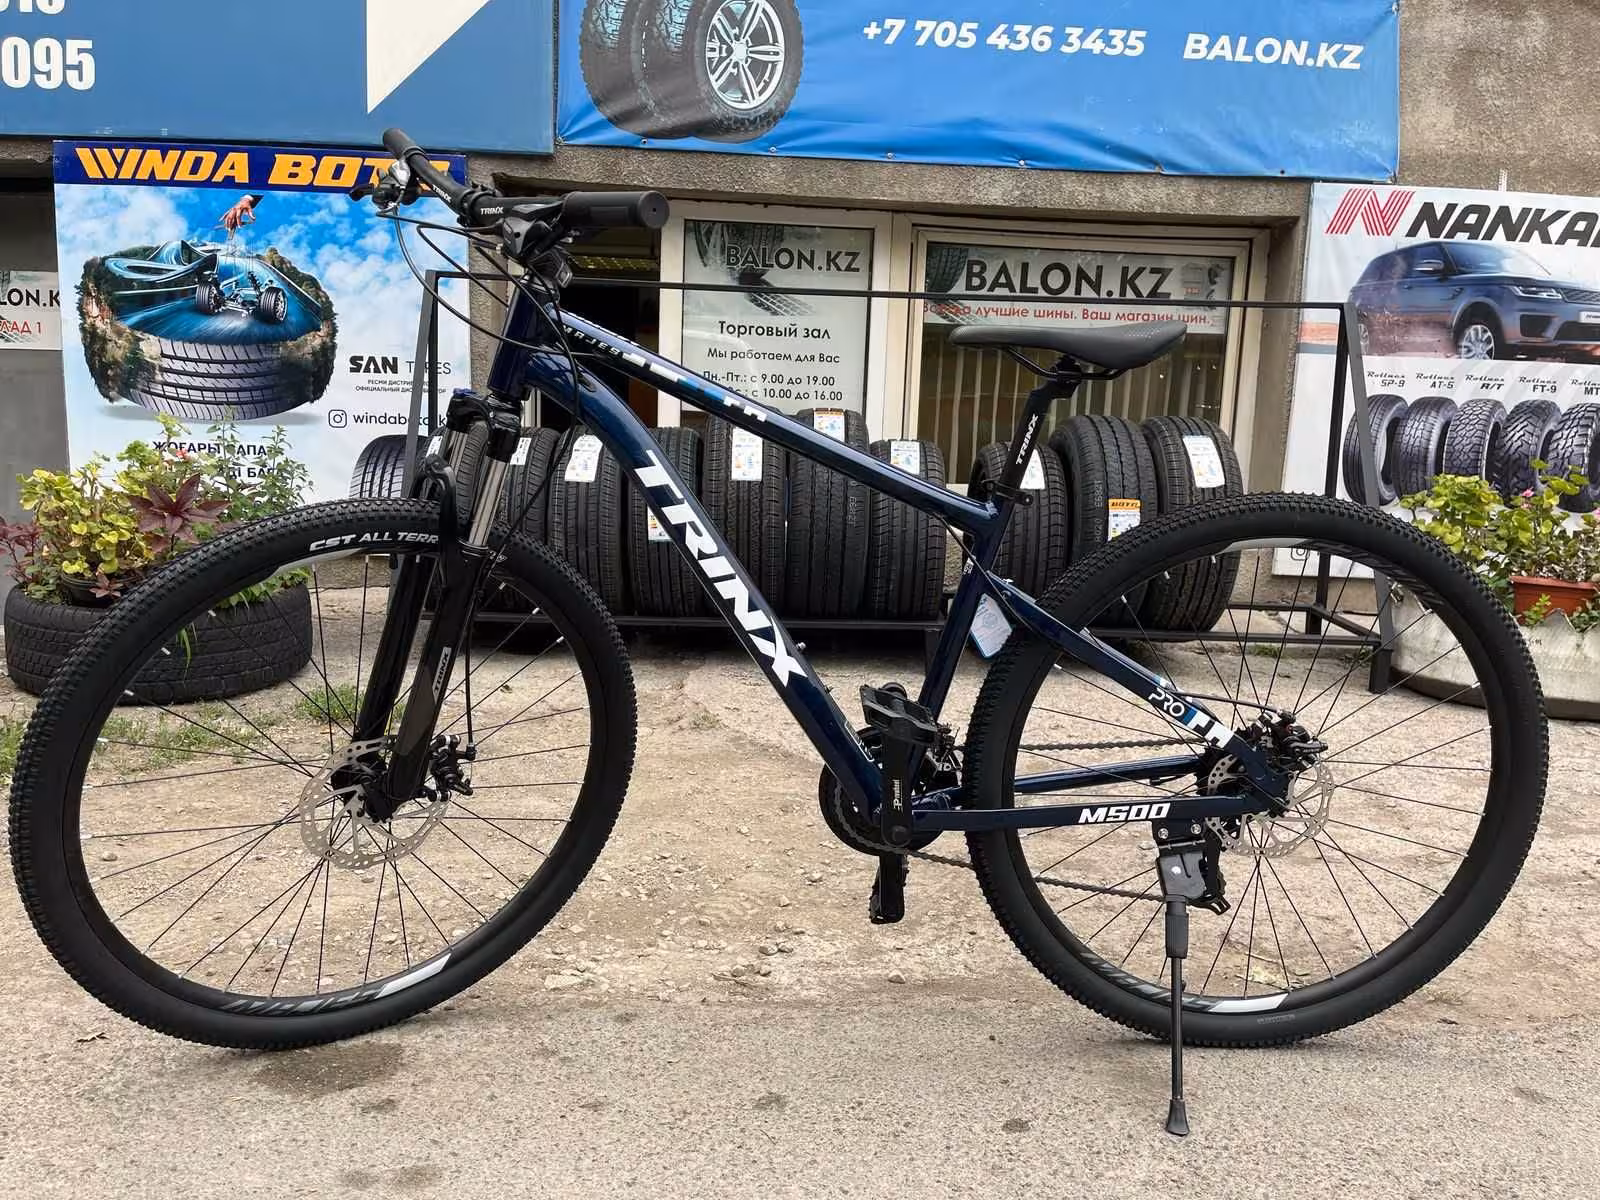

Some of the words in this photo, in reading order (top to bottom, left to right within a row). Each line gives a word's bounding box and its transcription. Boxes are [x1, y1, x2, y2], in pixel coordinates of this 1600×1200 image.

[863, 19, 905, 45] +7
[914, 20, 979, 48] 705
[986, 23, 1054, 52] 436
[1060, 27, 1147, 56] 3435
[1183, 33, 1365, 70] BALON.KZ
[2, 36, 96, 90] 095
[75, 147, 249, 184] WINDA
[432, 184, 451, 203] TRINX
[480, 207, 504, 215] TRINX
[1405, 201, 1600, 248] NANKA
[726, 244, 861, 273] BALON.KZ
[965, 259, 1173, 299] BALON.KZ
[975, 305, 1029, 318] лучшие
[1033, 308, 1077, 320] шины.
[1082, 308, 1111, 321] Ваш
[1115, 311, 1173, 322] магазин
[718, 320, 798, 338] Торговый
[802, 326, 831, 340] зал
[349, 355, 399, 374] SAN
[707, 348, 727, 358] Мы
[730, 349, 792, 362] работаем
[795, 352, 815, 363] для
[818, 353, 840, 363] Вас
[750, 375, 758, 383] с
[761, 373, 784, 384] 9.00
[787, 376, 802, 385] до
[806, 375, 835, 386] 19.00
[1480, 382, 1504, 390] R/T
[1532, 384, 1557, 393] FT-9
[762, 388, 792, 399] 10.00
[795, 391, 810, 400] до
[814, 390, 843, 401] 16.00
[1016, 413, 1038, 464] TRINX
[310, 534, 356, 551] CST
[359, 532, 393, 542] ALL
[634, 450, 809, 687] TRINX
[1148, 687, 1185, 717] PRO
[1078, 803, 1171, 824] M500
